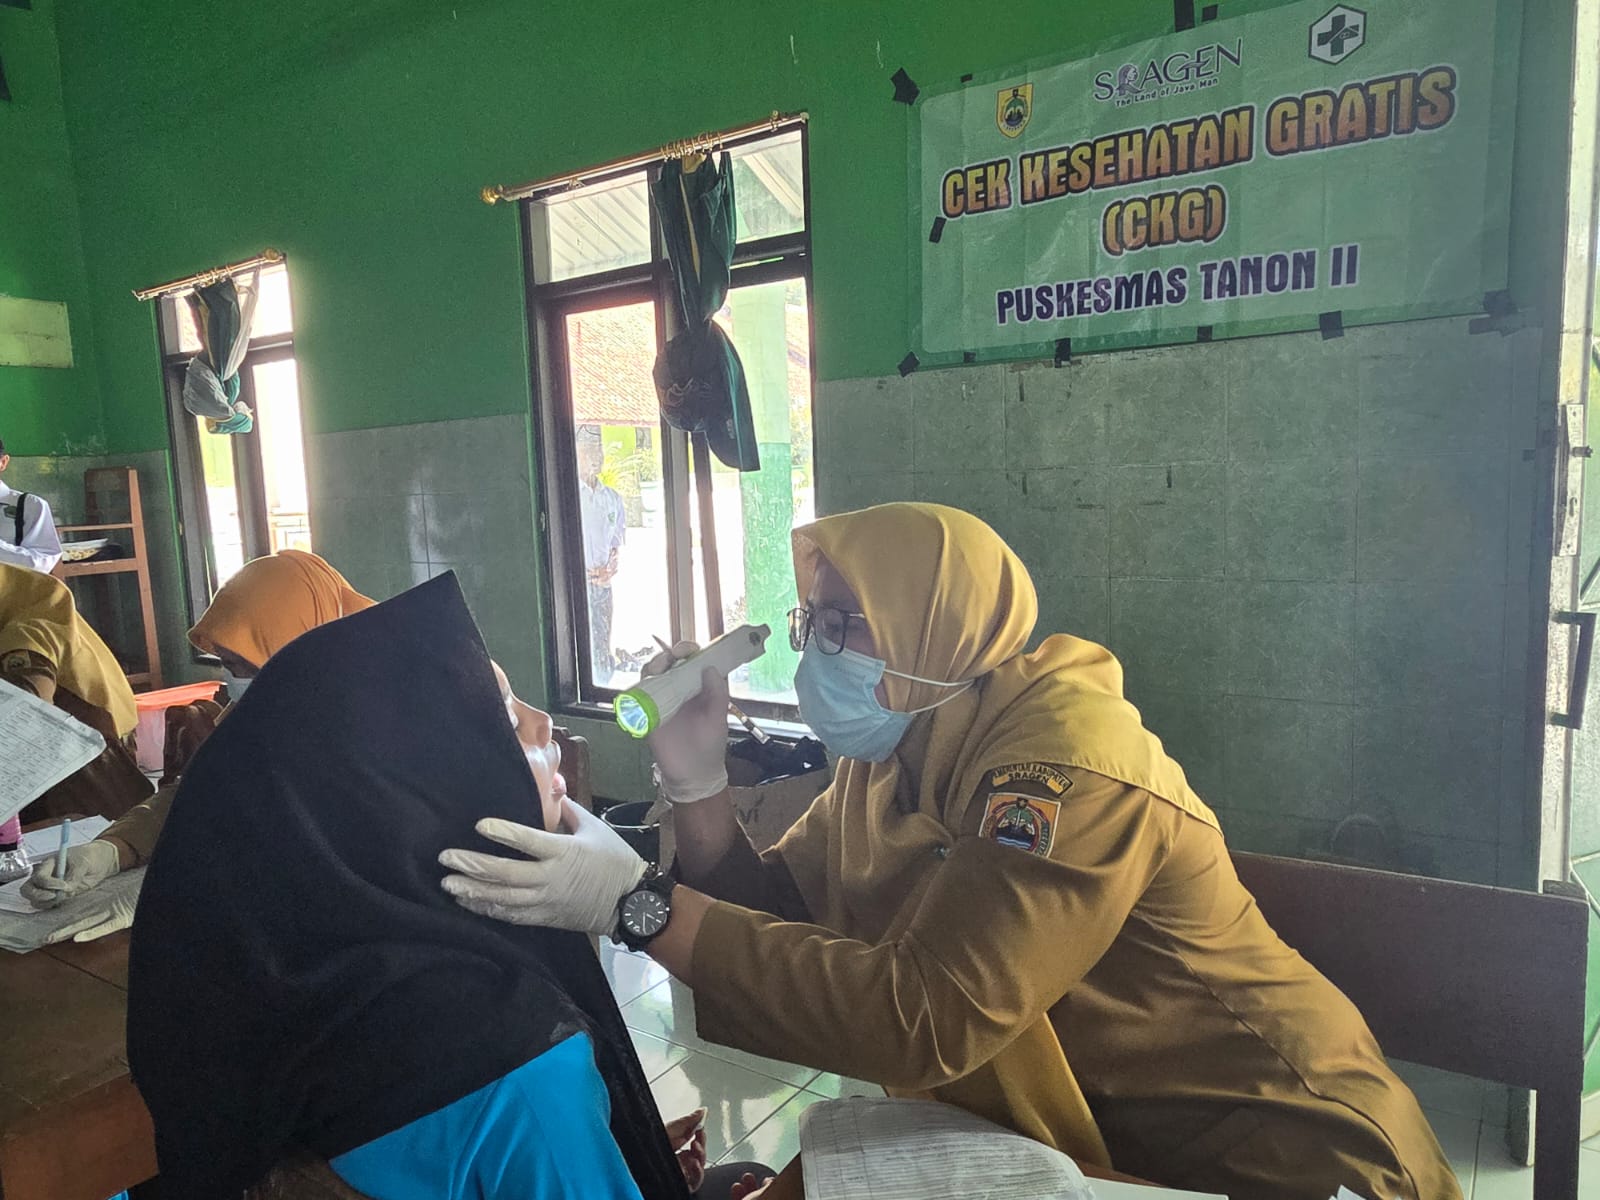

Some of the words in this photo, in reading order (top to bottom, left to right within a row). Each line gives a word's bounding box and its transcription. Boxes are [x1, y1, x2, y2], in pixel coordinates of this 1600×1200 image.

[1115, 97, 1132, 107] The
[1134, 91, 1157, 103] Land
[1160, 87, 1170, 96] of
[1174, 84, 1195, 94] Java
[1200, 78, 1218, 88] Man
[942, 158, 1012, 218] CEK
[1019, 105, 1254, 205] KESEHATAN
[1266, 66, 1456, 156] GRATIS
[1103, 185, 1226, 255] (CKG)
[997, 267, 1187, 325] PUSKESMAS
[1200, 250, 1317, 300] TANON
[1330, 244, 1358, 286] II
